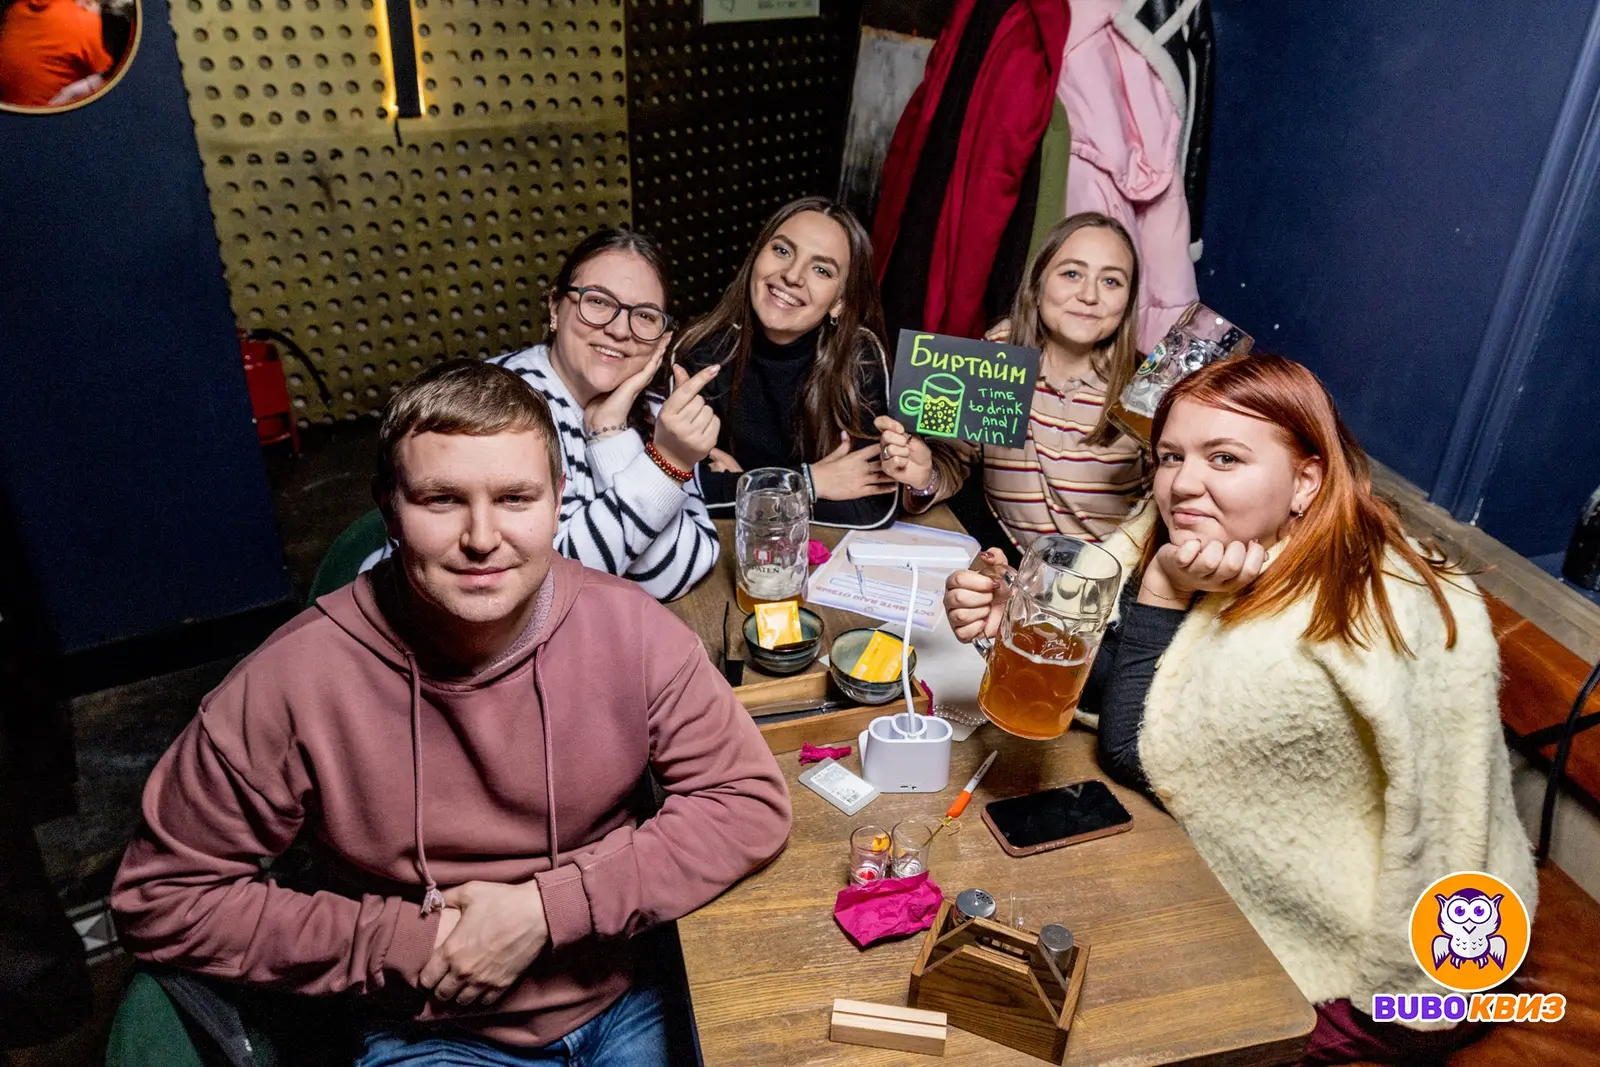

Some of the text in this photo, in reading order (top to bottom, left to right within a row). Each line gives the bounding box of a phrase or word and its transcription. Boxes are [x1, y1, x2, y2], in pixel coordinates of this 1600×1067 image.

[968, 400, 1024, 416] to drink
[879, 601, 935, 617] ОСТВЬТЕ
